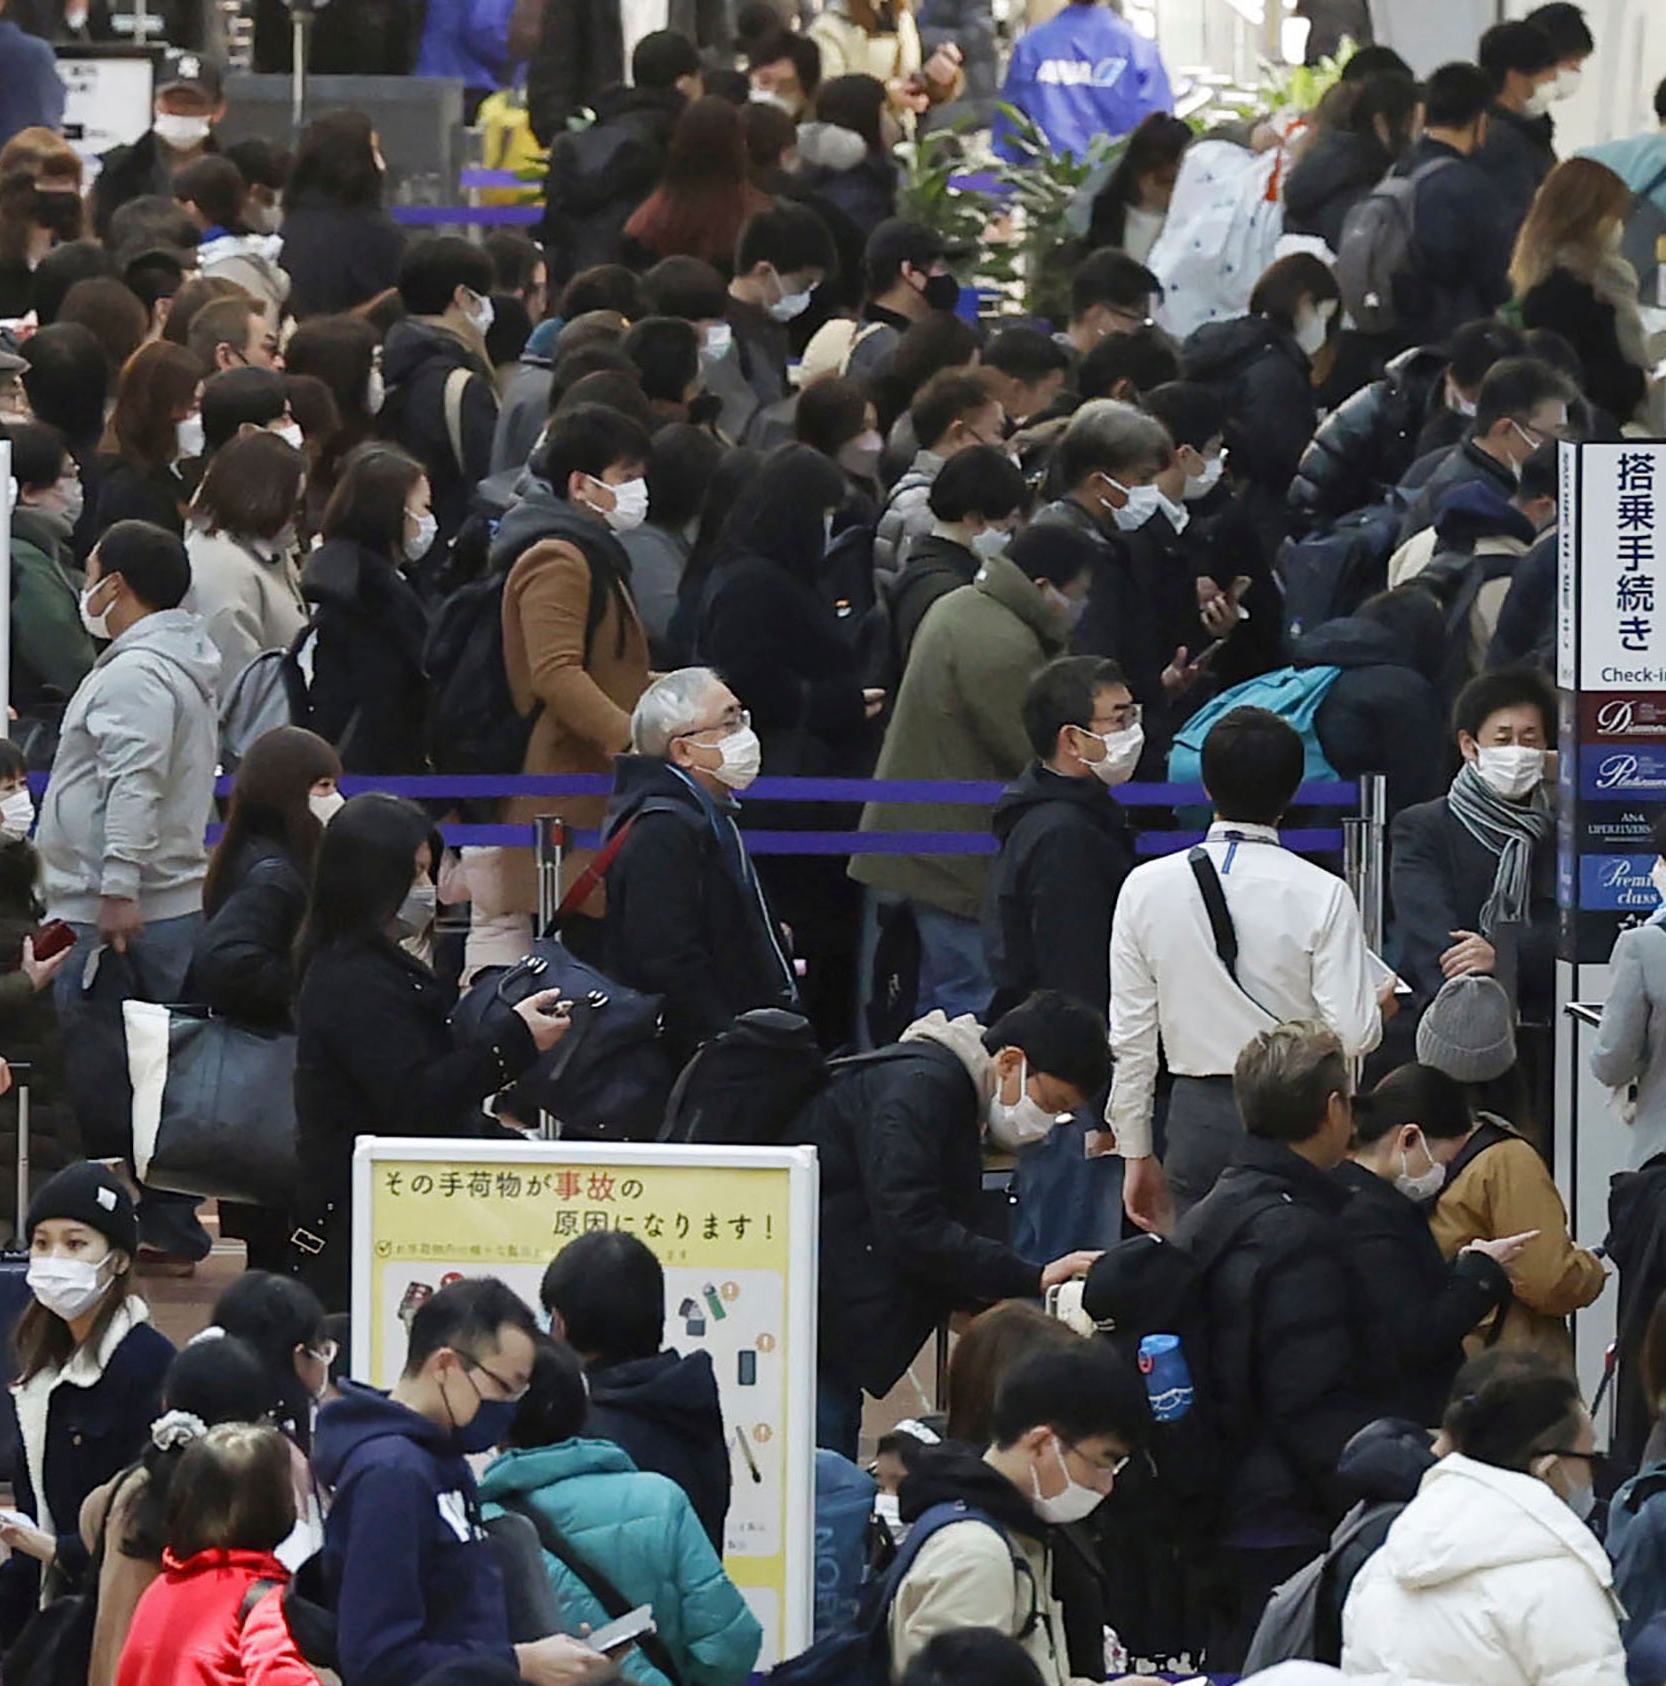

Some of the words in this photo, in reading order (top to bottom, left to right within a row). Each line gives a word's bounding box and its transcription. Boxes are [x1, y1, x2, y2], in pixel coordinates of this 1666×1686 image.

[1616, 452, 1656, 652] 搭乗手続き
[1598, 859, 1653, 887] Premi
[1617, 889, 1658, 906] class
[385, 1170, 645, 1202] その手荷物が事故の
